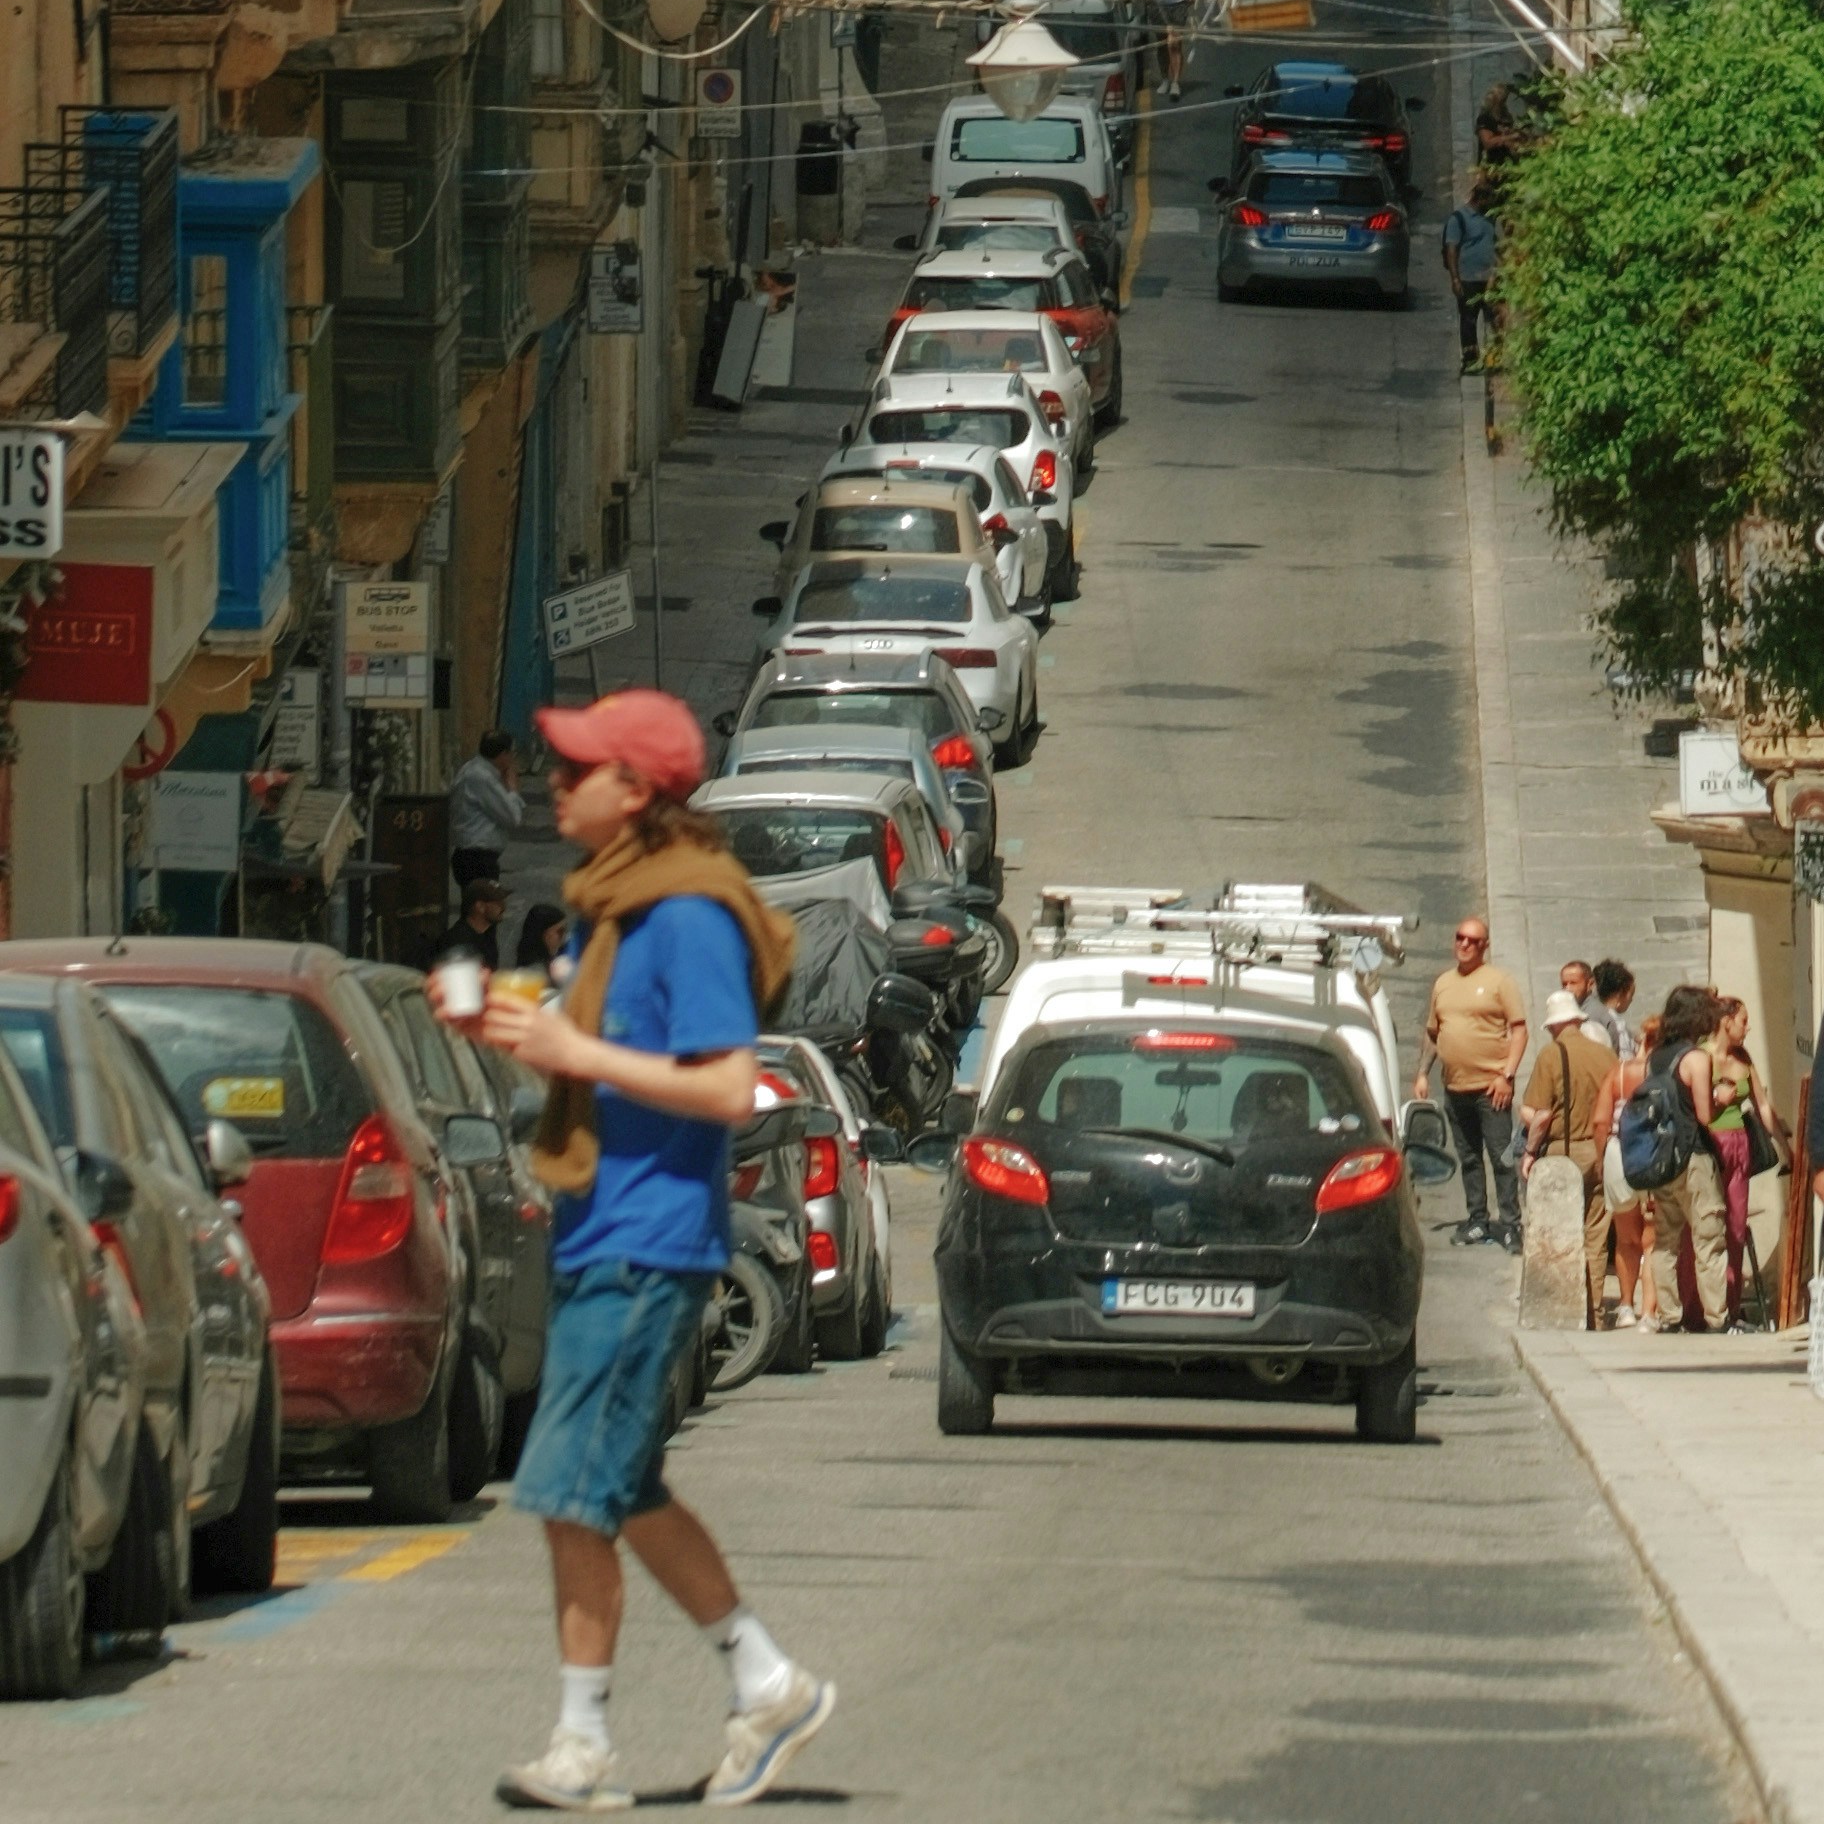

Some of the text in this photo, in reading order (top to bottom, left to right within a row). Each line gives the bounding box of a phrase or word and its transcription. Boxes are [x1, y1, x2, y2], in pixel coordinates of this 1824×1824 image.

[357, 606, 418, 616] BUS STOP
[1123, 1282, 1244, 1308] FCG 904
